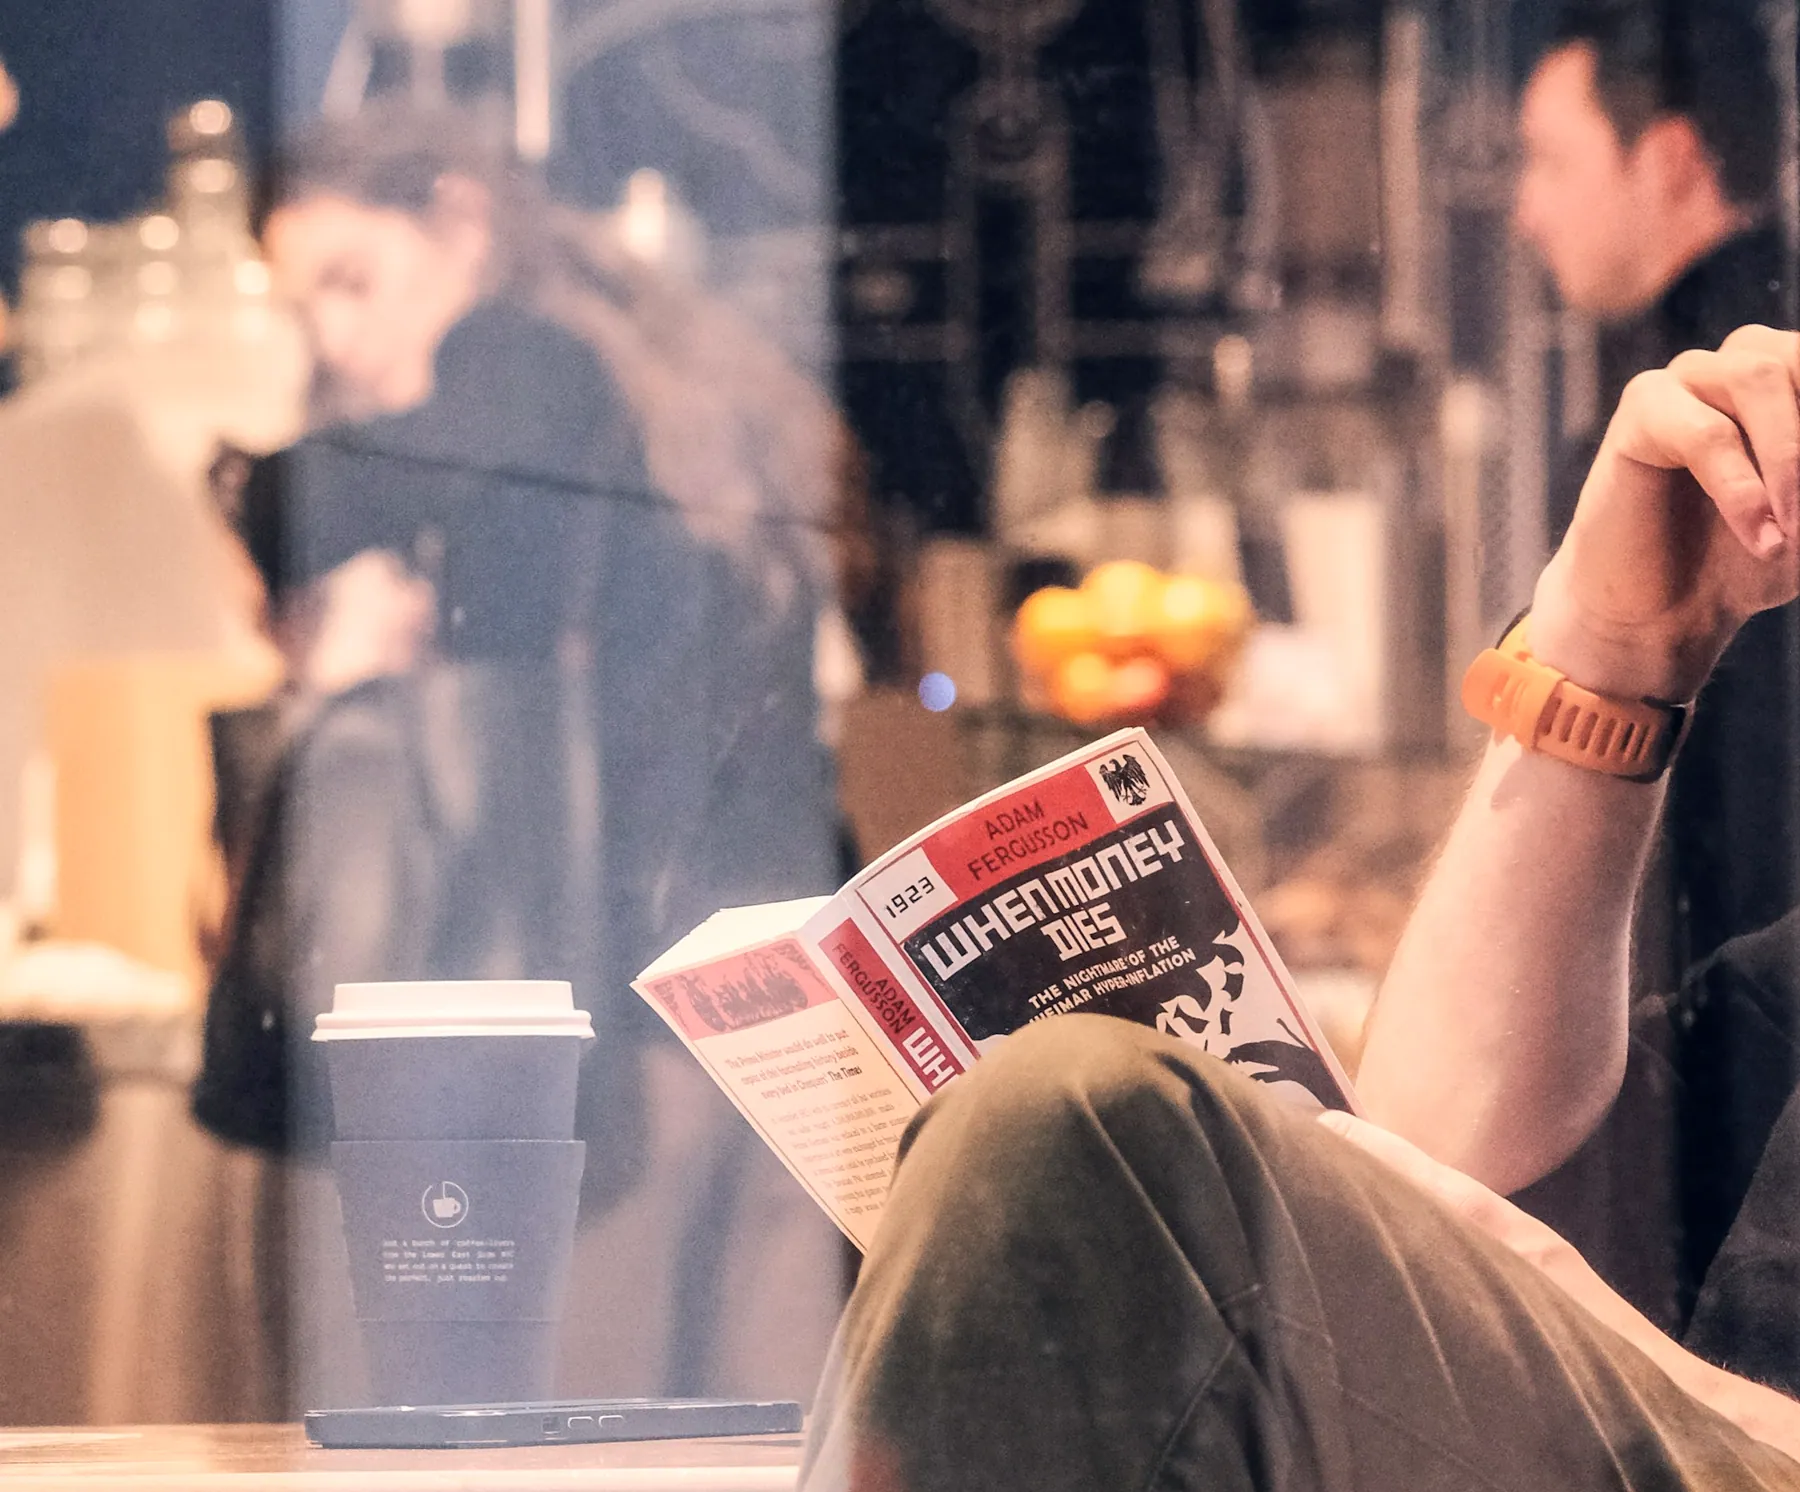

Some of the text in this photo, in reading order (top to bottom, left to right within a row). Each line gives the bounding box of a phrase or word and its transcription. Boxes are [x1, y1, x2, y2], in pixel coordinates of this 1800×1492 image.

[984, 800, 1045, 840] ADAM
[967, 812, 1089, 881] FERGUSSON
[884, 876, 936, 918] 1923
[1040, 901, 1127, 962] DIES
[832, 943, 905, 1034] FERGUSSON
[1028, 935, 1180, 1009] THE NIGHTMARE OF THE
[1092, 948, 1196, 996] HYPER-INFLATION
[876, 979, 917, 1025] ADAM
[827, 1070, 843, 1081] The
[840, 1065, 862, 1078] Times
[451, 1251, 471, 1259] East
